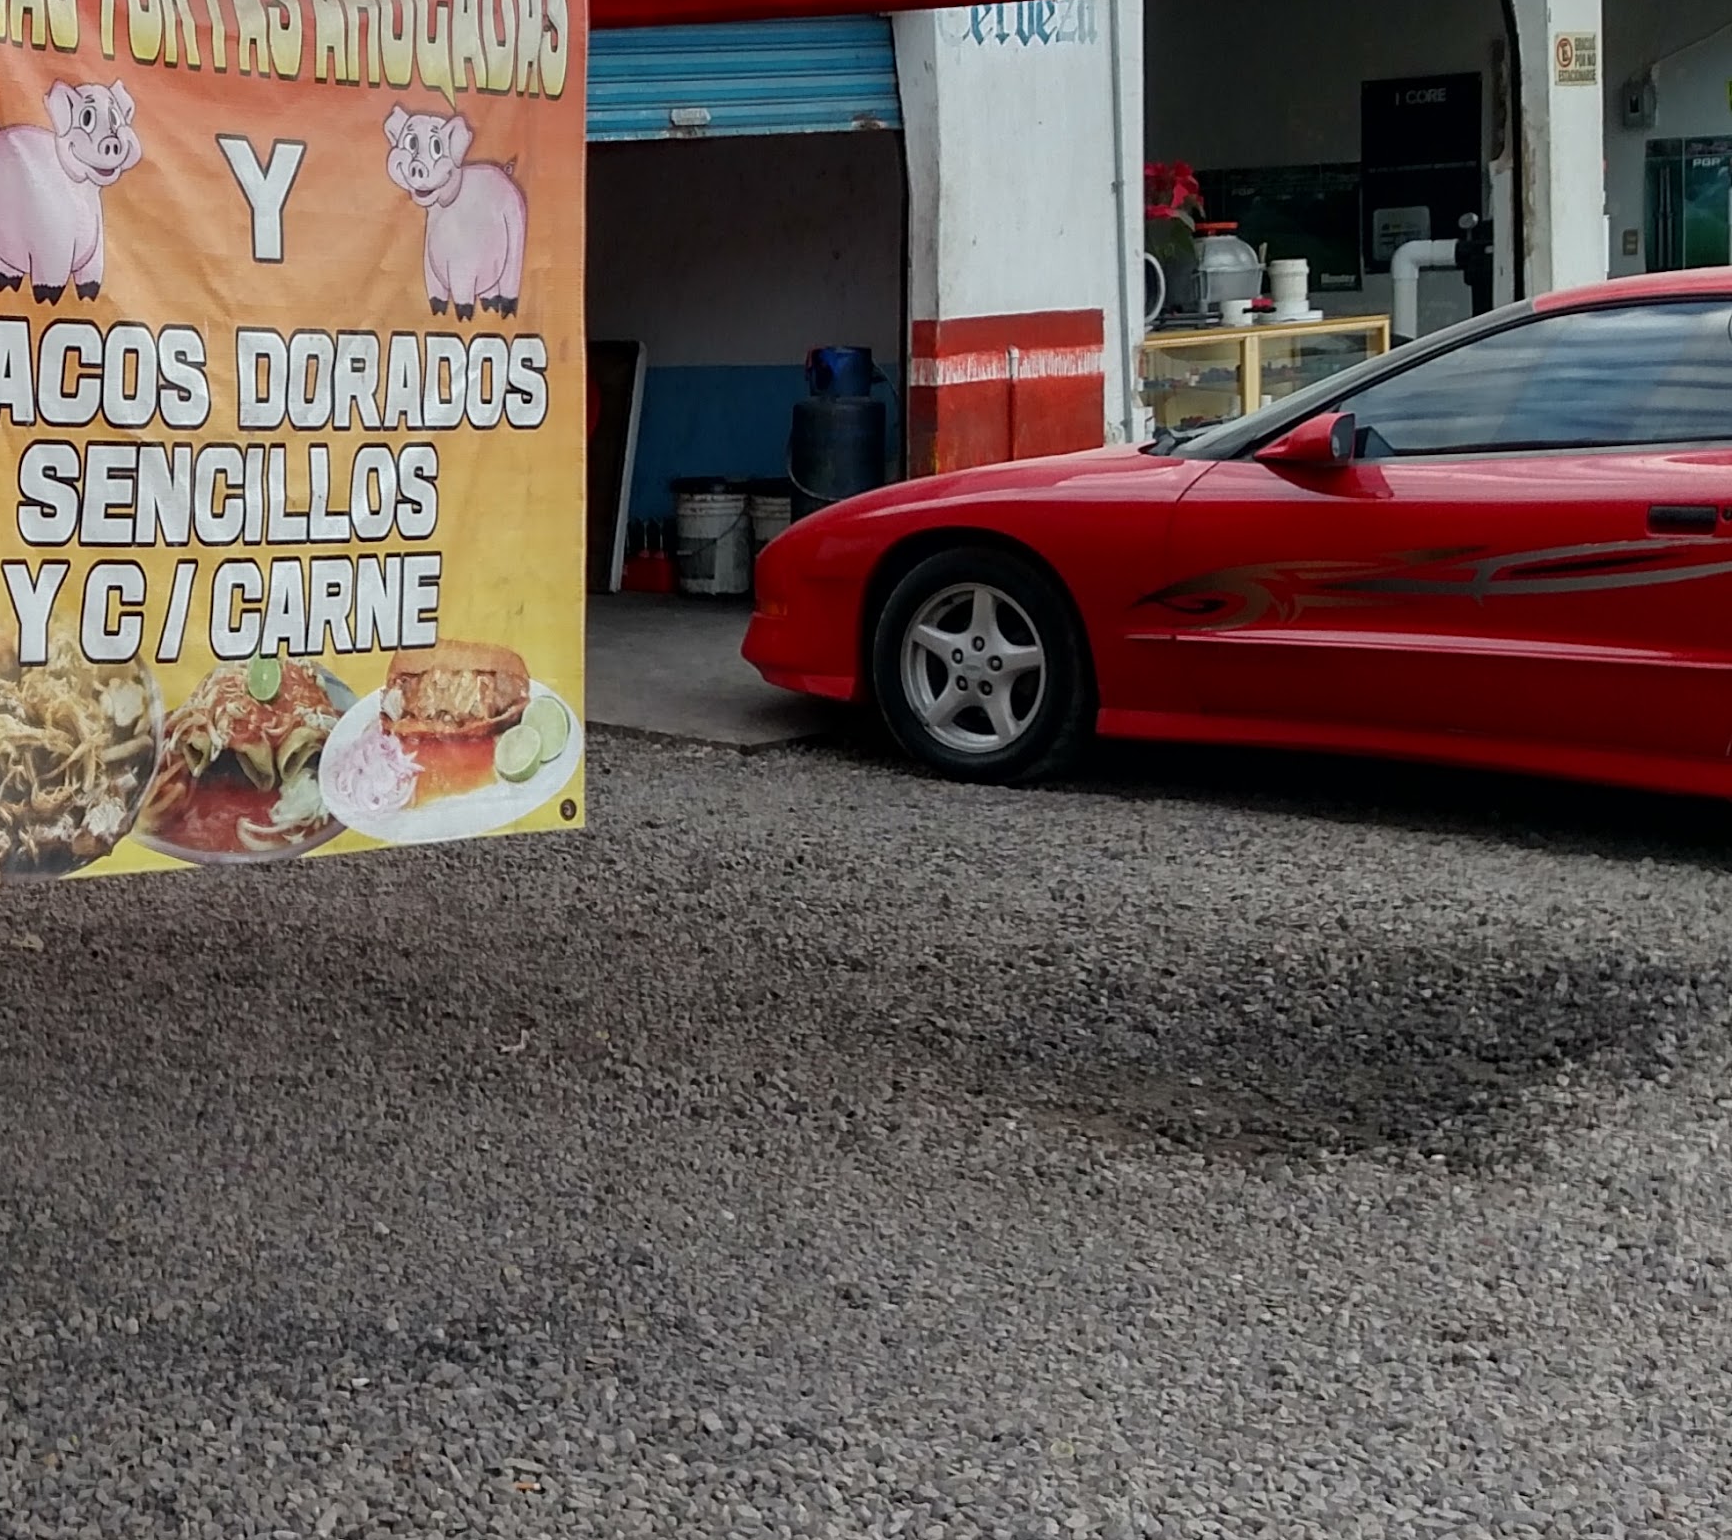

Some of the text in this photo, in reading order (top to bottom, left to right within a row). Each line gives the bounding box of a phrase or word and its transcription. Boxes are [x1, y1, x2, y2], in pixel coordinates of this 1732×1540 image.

[216, 134, 307, 264] Y
[236, 325, 550, 431] DORADOS
[16, 438, 440, 547] SENCILLOS
[1, 559, 71, 667] Y
[207, 550, 443, 662] CARNE
